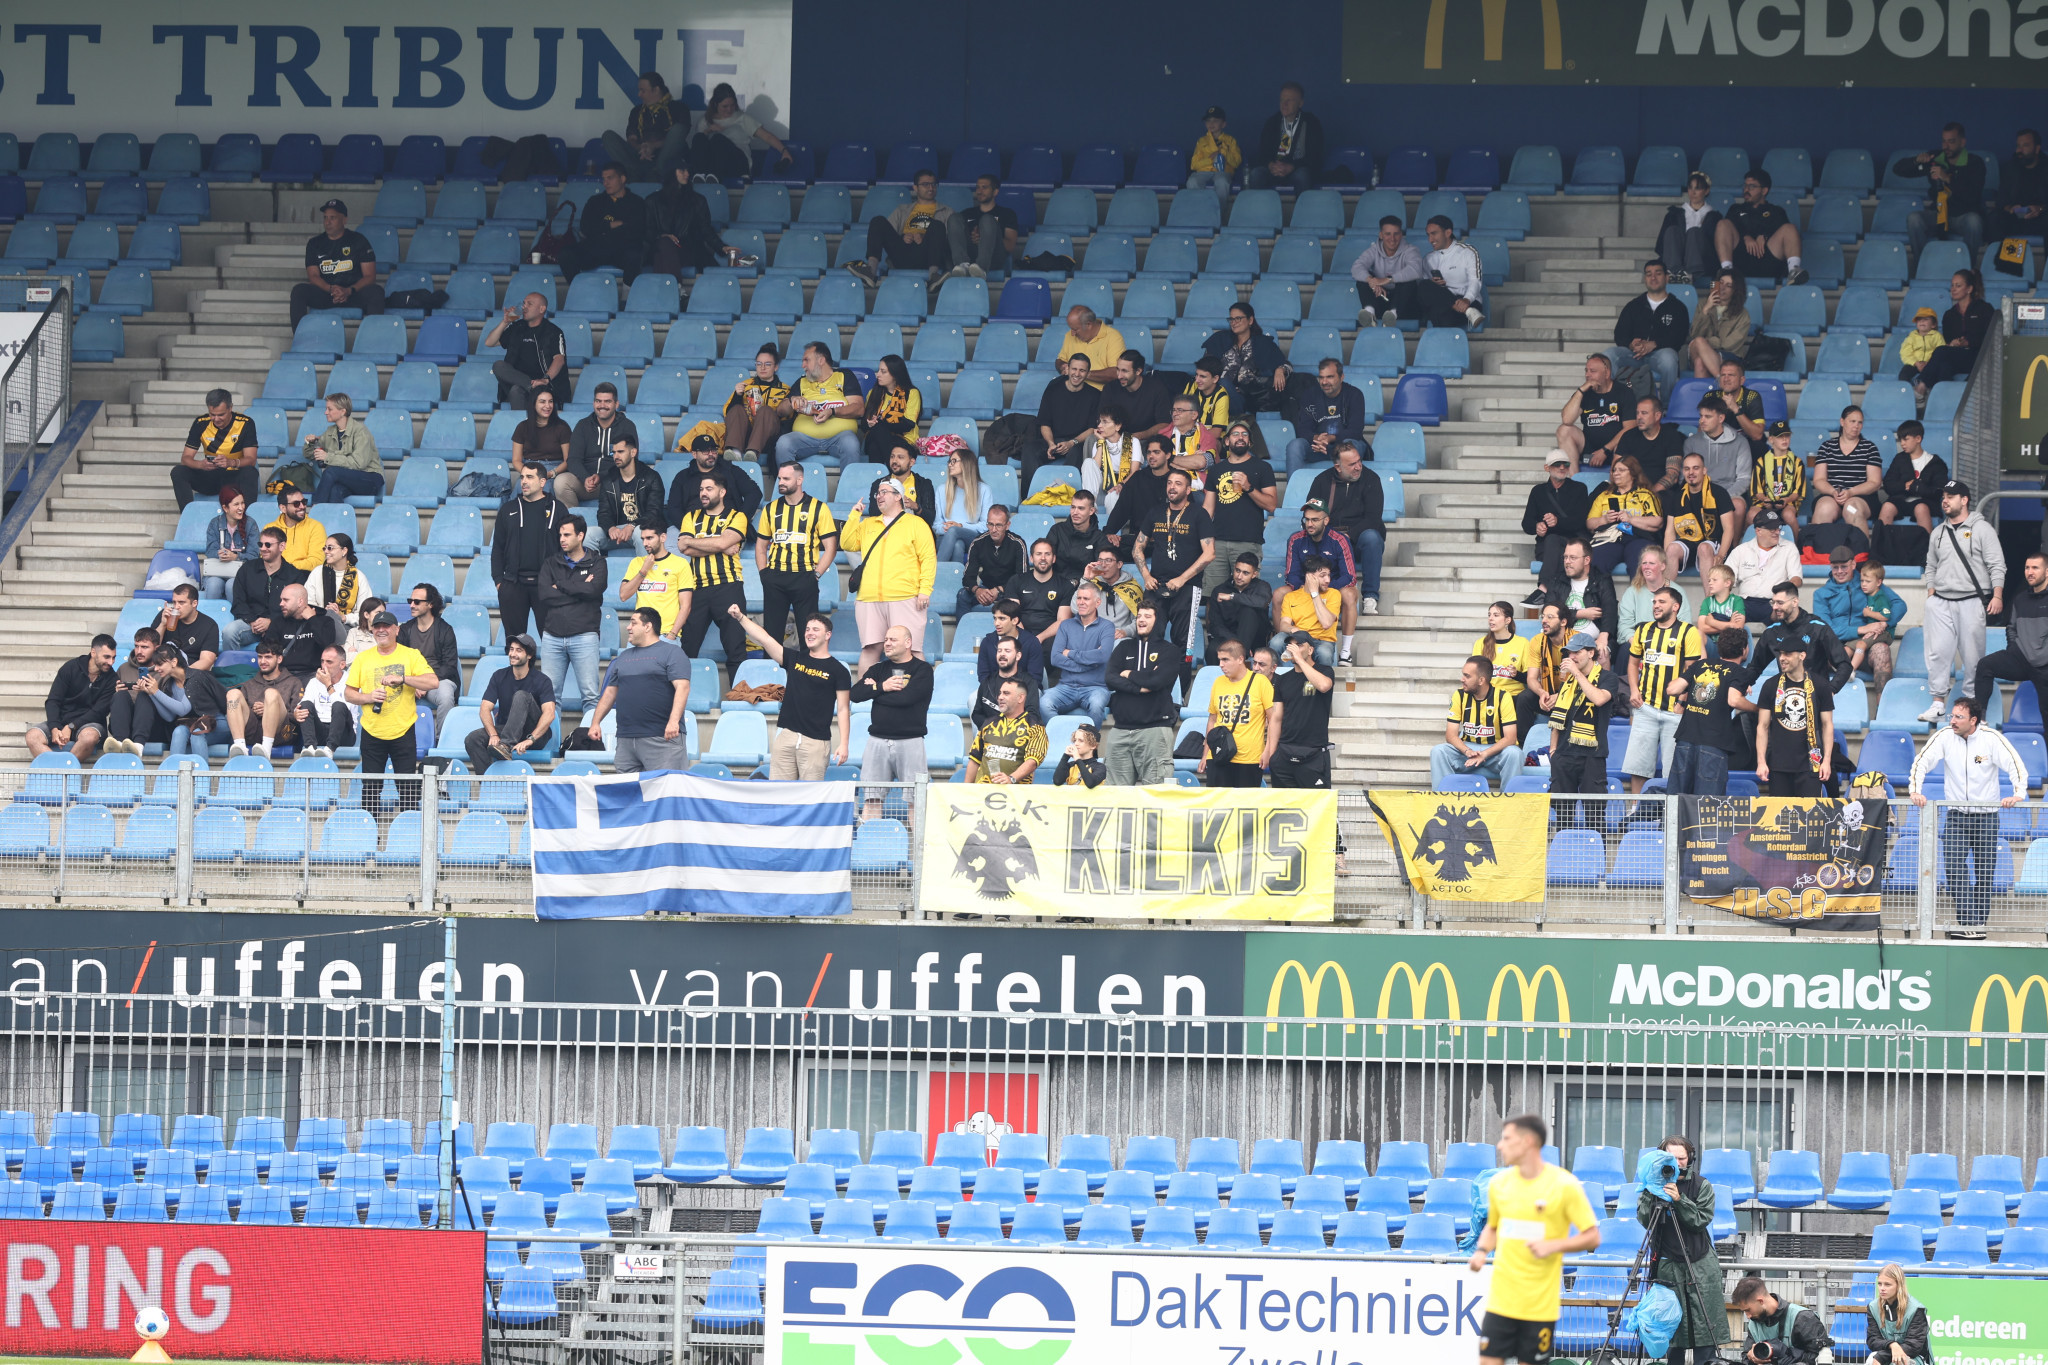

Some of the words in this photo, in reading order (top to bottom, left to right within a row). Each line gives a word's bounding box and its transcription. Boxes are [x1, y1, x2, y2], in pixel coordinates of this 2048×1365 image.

[0, 22, 102, 105] T
[152, 24, 746, 112] TRIBUNE
[1696, 840, 1716, 849] haag
[1750, 833, 1792, 842] Amsterdam
[1063, 806, 1309, 897] KILKIS
[1766, 842, 1807, 851] Rotterdam
[1692, 853, 1727, 863] Groningen
[1786, 852, 1828, 861] Maastricht
[1701, 866, 1730, 875] Utrecht
[1608, 963, 1932, 1012] McDonald's
[1608, 1013, 1700, 1036] Heerde
[1721, 1015, 1826, 1044] Kampen
[1846, 1017, 1928, 1041] Zwolle
[633, 1257, 658, 1267] ABC
[5, 1242, 232, 1334] RING
[1110, 1270, 1484, 1336] DakTechniek
[1538, 1327, 1552, 1352] 3
